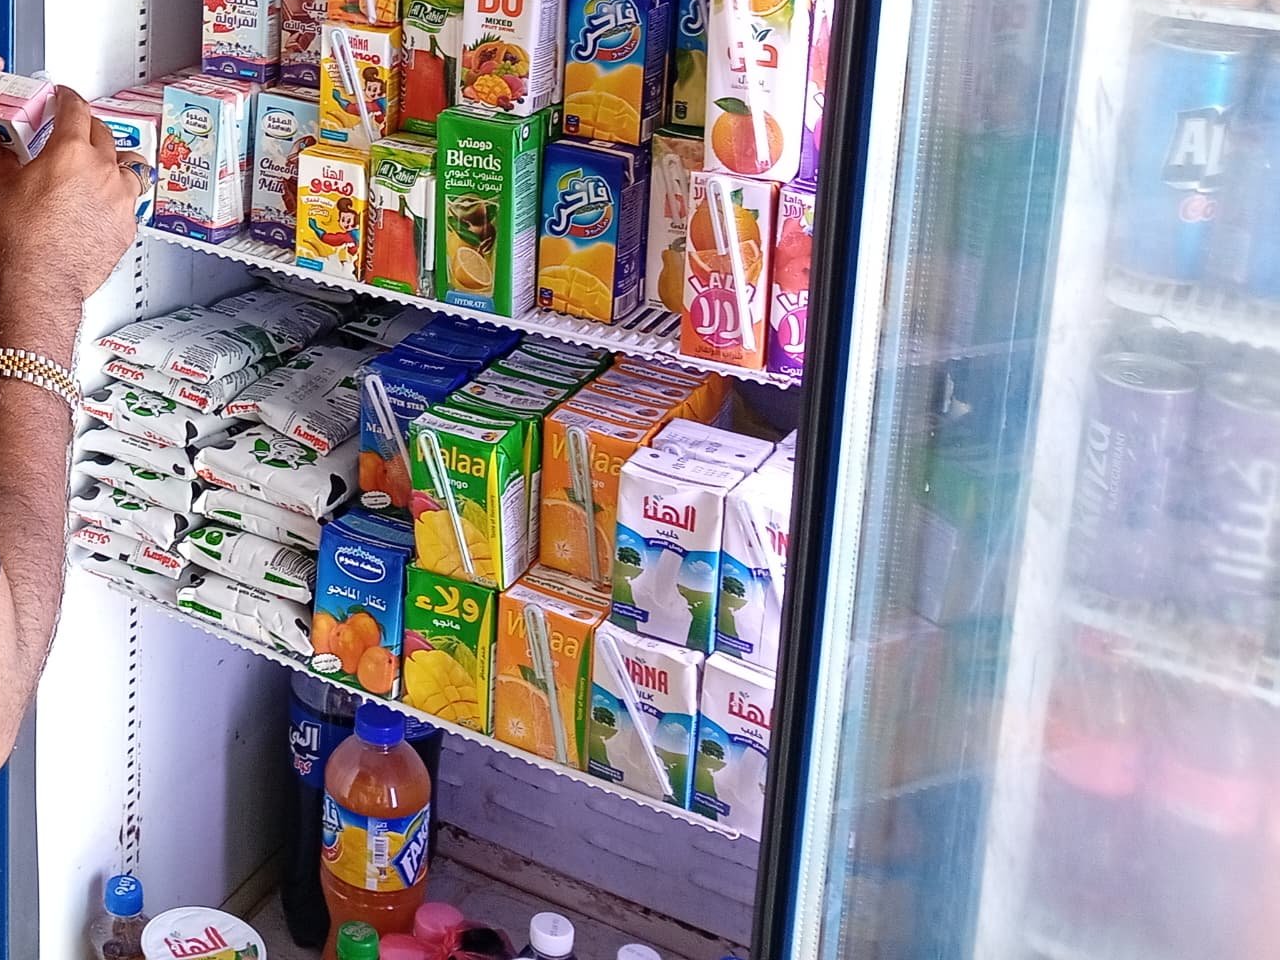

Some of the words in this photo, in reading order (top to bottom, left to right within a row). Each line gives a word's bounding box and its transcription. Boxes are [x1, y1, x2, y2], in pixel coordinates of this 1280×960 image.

[283, 21, 322, 35] وكولاته
[485, 16, 513, 27] MIXED
[457, 137, 493, 151] دومتي
[260, 157, 299, 176] Chocola
[446, 149, 502, 172] Blends
[472, 171, 504, 182] مشروب
[444, 178, 476, 190] بالنعناع
[477, 182, 503, 193] ليمون
[453, 297, 487, 309] HYDRATE
[642, 494, 697, 534] الهنا
[655, 528, 680, 540] حليب
[326, 583, 360, 601] المانجو
[362, 593, 387, 612] نكتار
[414, 584, 480, 623] ولاء
[431, 618, 462, 631] مانجو
[740, 726, 764, 740] حليب
[164, 925, 228, 959] الهنا
